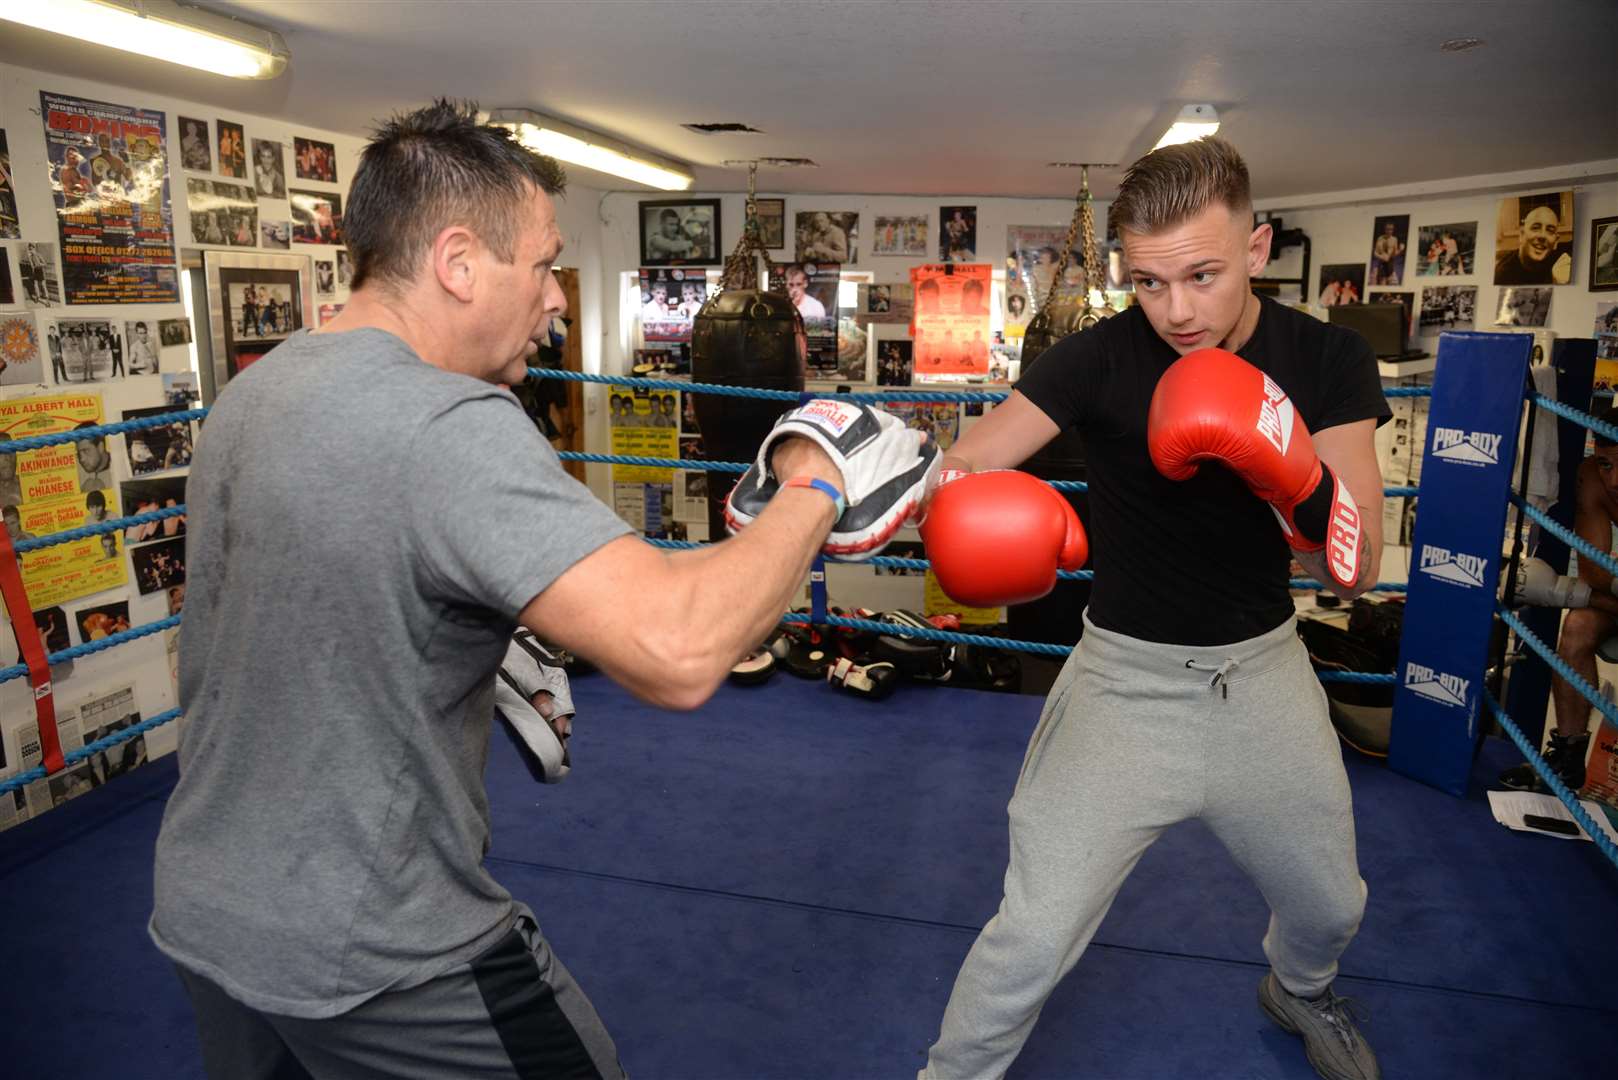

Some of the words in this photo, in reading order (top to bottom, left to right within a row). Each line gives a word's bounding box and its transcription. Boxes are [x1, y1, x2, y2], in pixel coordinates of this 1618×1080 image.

[49, 103, 86, 114] WORLD
[65, 245, 84, 255] BOX
[86, 246, 114, 256] OFFICE
[22, 402, 65, 414] ALBERT
[68, 398, 95, 410] HALL
[1432, 427, 1502, 461] PRO-BOX
[20, 455, 76, 473] AKINWANDE
[28, 480, 75, 498] CHIANESE
[1420, 544, 1488, 584] PRO-BOX
[1405, 661, 1470, 704] PRO-BOX
